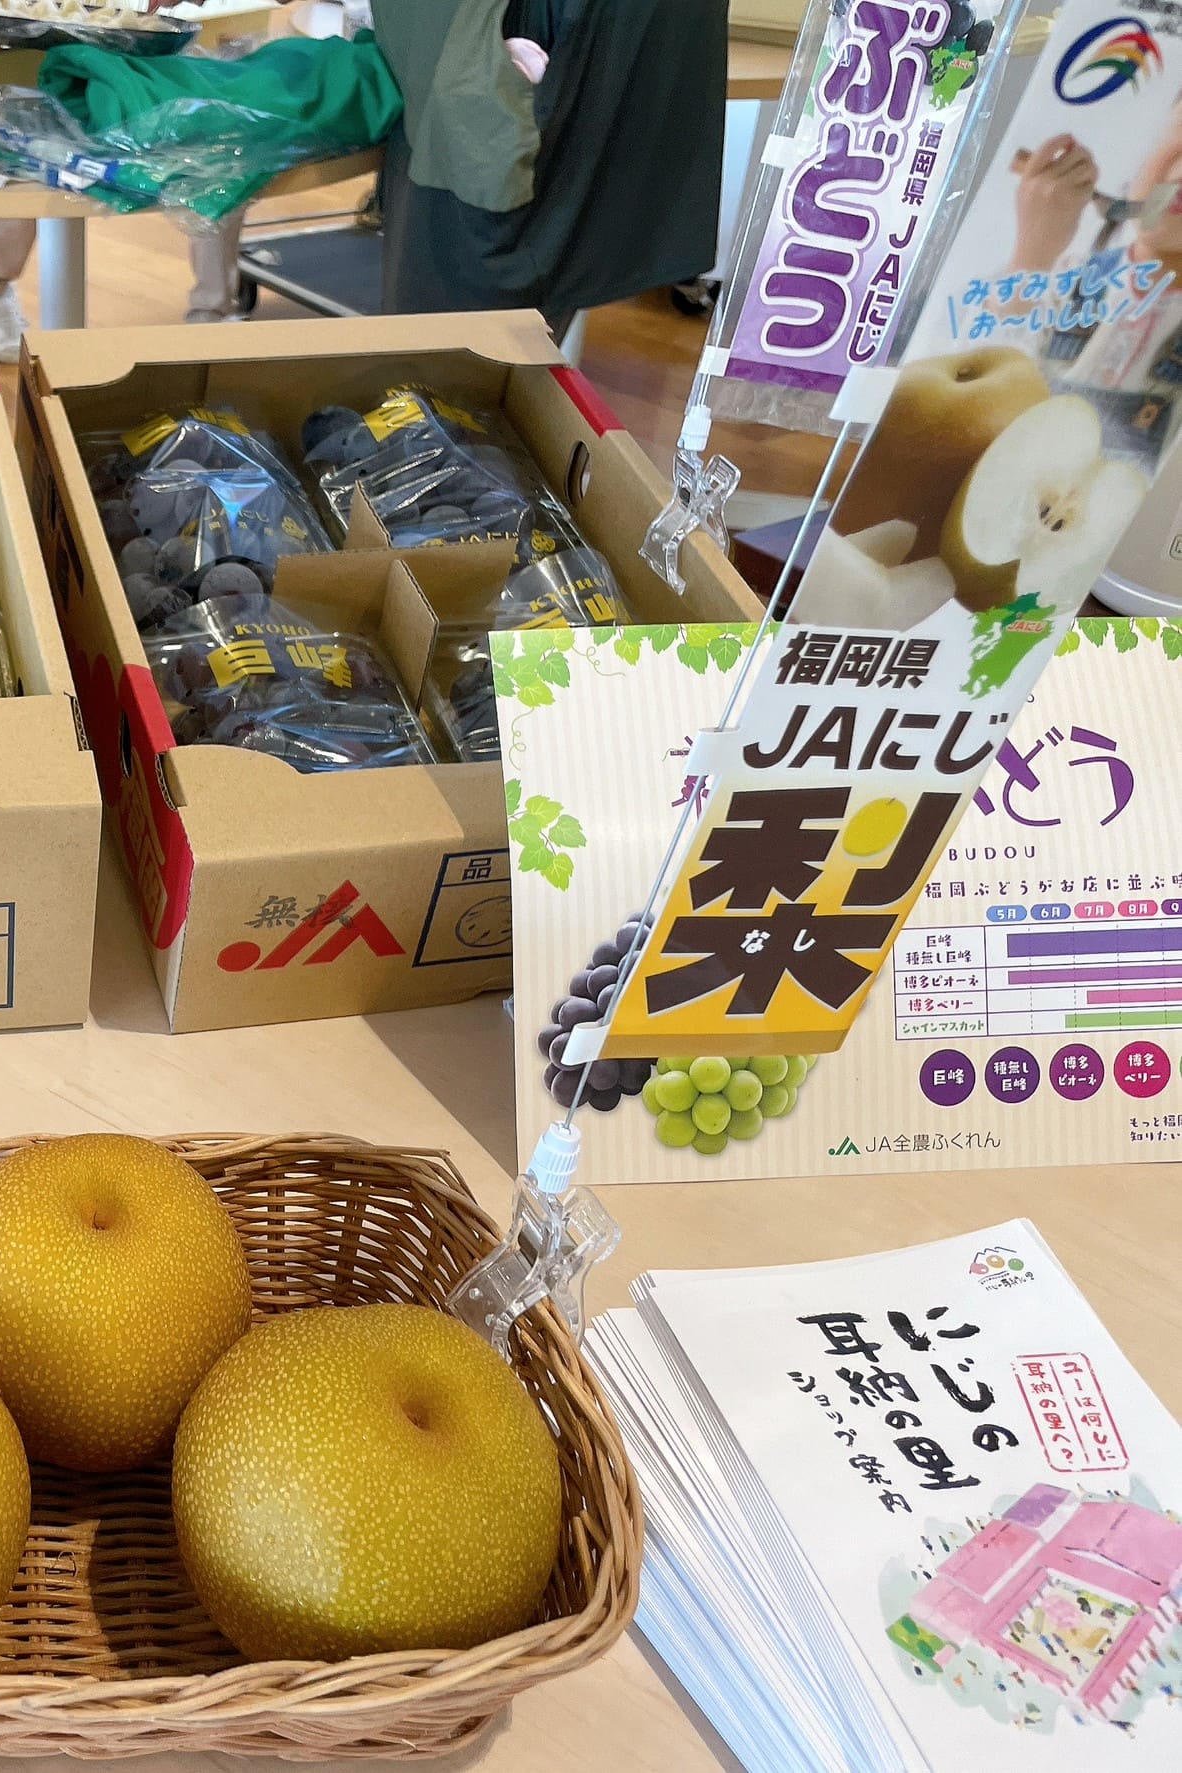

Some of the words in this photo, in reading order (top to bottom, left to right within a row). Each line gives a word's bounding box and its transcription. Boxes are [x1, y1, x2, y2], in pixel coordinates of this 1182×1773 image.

[901, 119, 945, 206] 福岡県
[760, 0, 951, 356] ぶどう
[848, 215, 918, 363] JAにじ
[963, 261, 1163, 306] みずみずしくて
[234, 623, 311, 637] KYOHO
[206, 640, 353, 688] 巨峰
[774, 631, 940, 690] 福岡県
[742, 705, 1009, 776] JAにじ
[974, 725, 1135, 829] どう
[949, 845, 1036, 862] BUDOU
[644, 787, 963, 1018] 梨
[996, 910, 1017, 921] 5月
[1040, 908, 1061, 919] 6月
[1084, 906, 1104, 918] 7月
[1128, 904, 1148, 916] 8月
[739, 928, 817, 955] なし
[926, 935, 953, 948] 巨峰
[905, 950, 972, 965] 種無し巨峰
[903, 973, 979, 990] 博多ピオーネ
[907, 998, 974, 1013] 博多ベリー
[902, 1019, 985, 1034] シャインマスカット
[993, 1060, 1030, 1075] 種無し
[1063, 1054, 1090, 1070] 博多
[1127, 1052, 1155, 1067] 博多
[933, 1068, 965, 1086] 巨峰
[1001, 1077, 1027, 1092] 巨峰
[1058, 1074, 1097, 1087] ピオーネ
[1124, 1072, 1162, 1083] ベリー
[865, 1131, 1001, 1153] JA全農ふくれん
[887, 1306, 1020, 1452] にじの
[796, 1312, 982, 1490] 耳納の里
[1062, 1361, 1116, 1461] ユーは何しに
